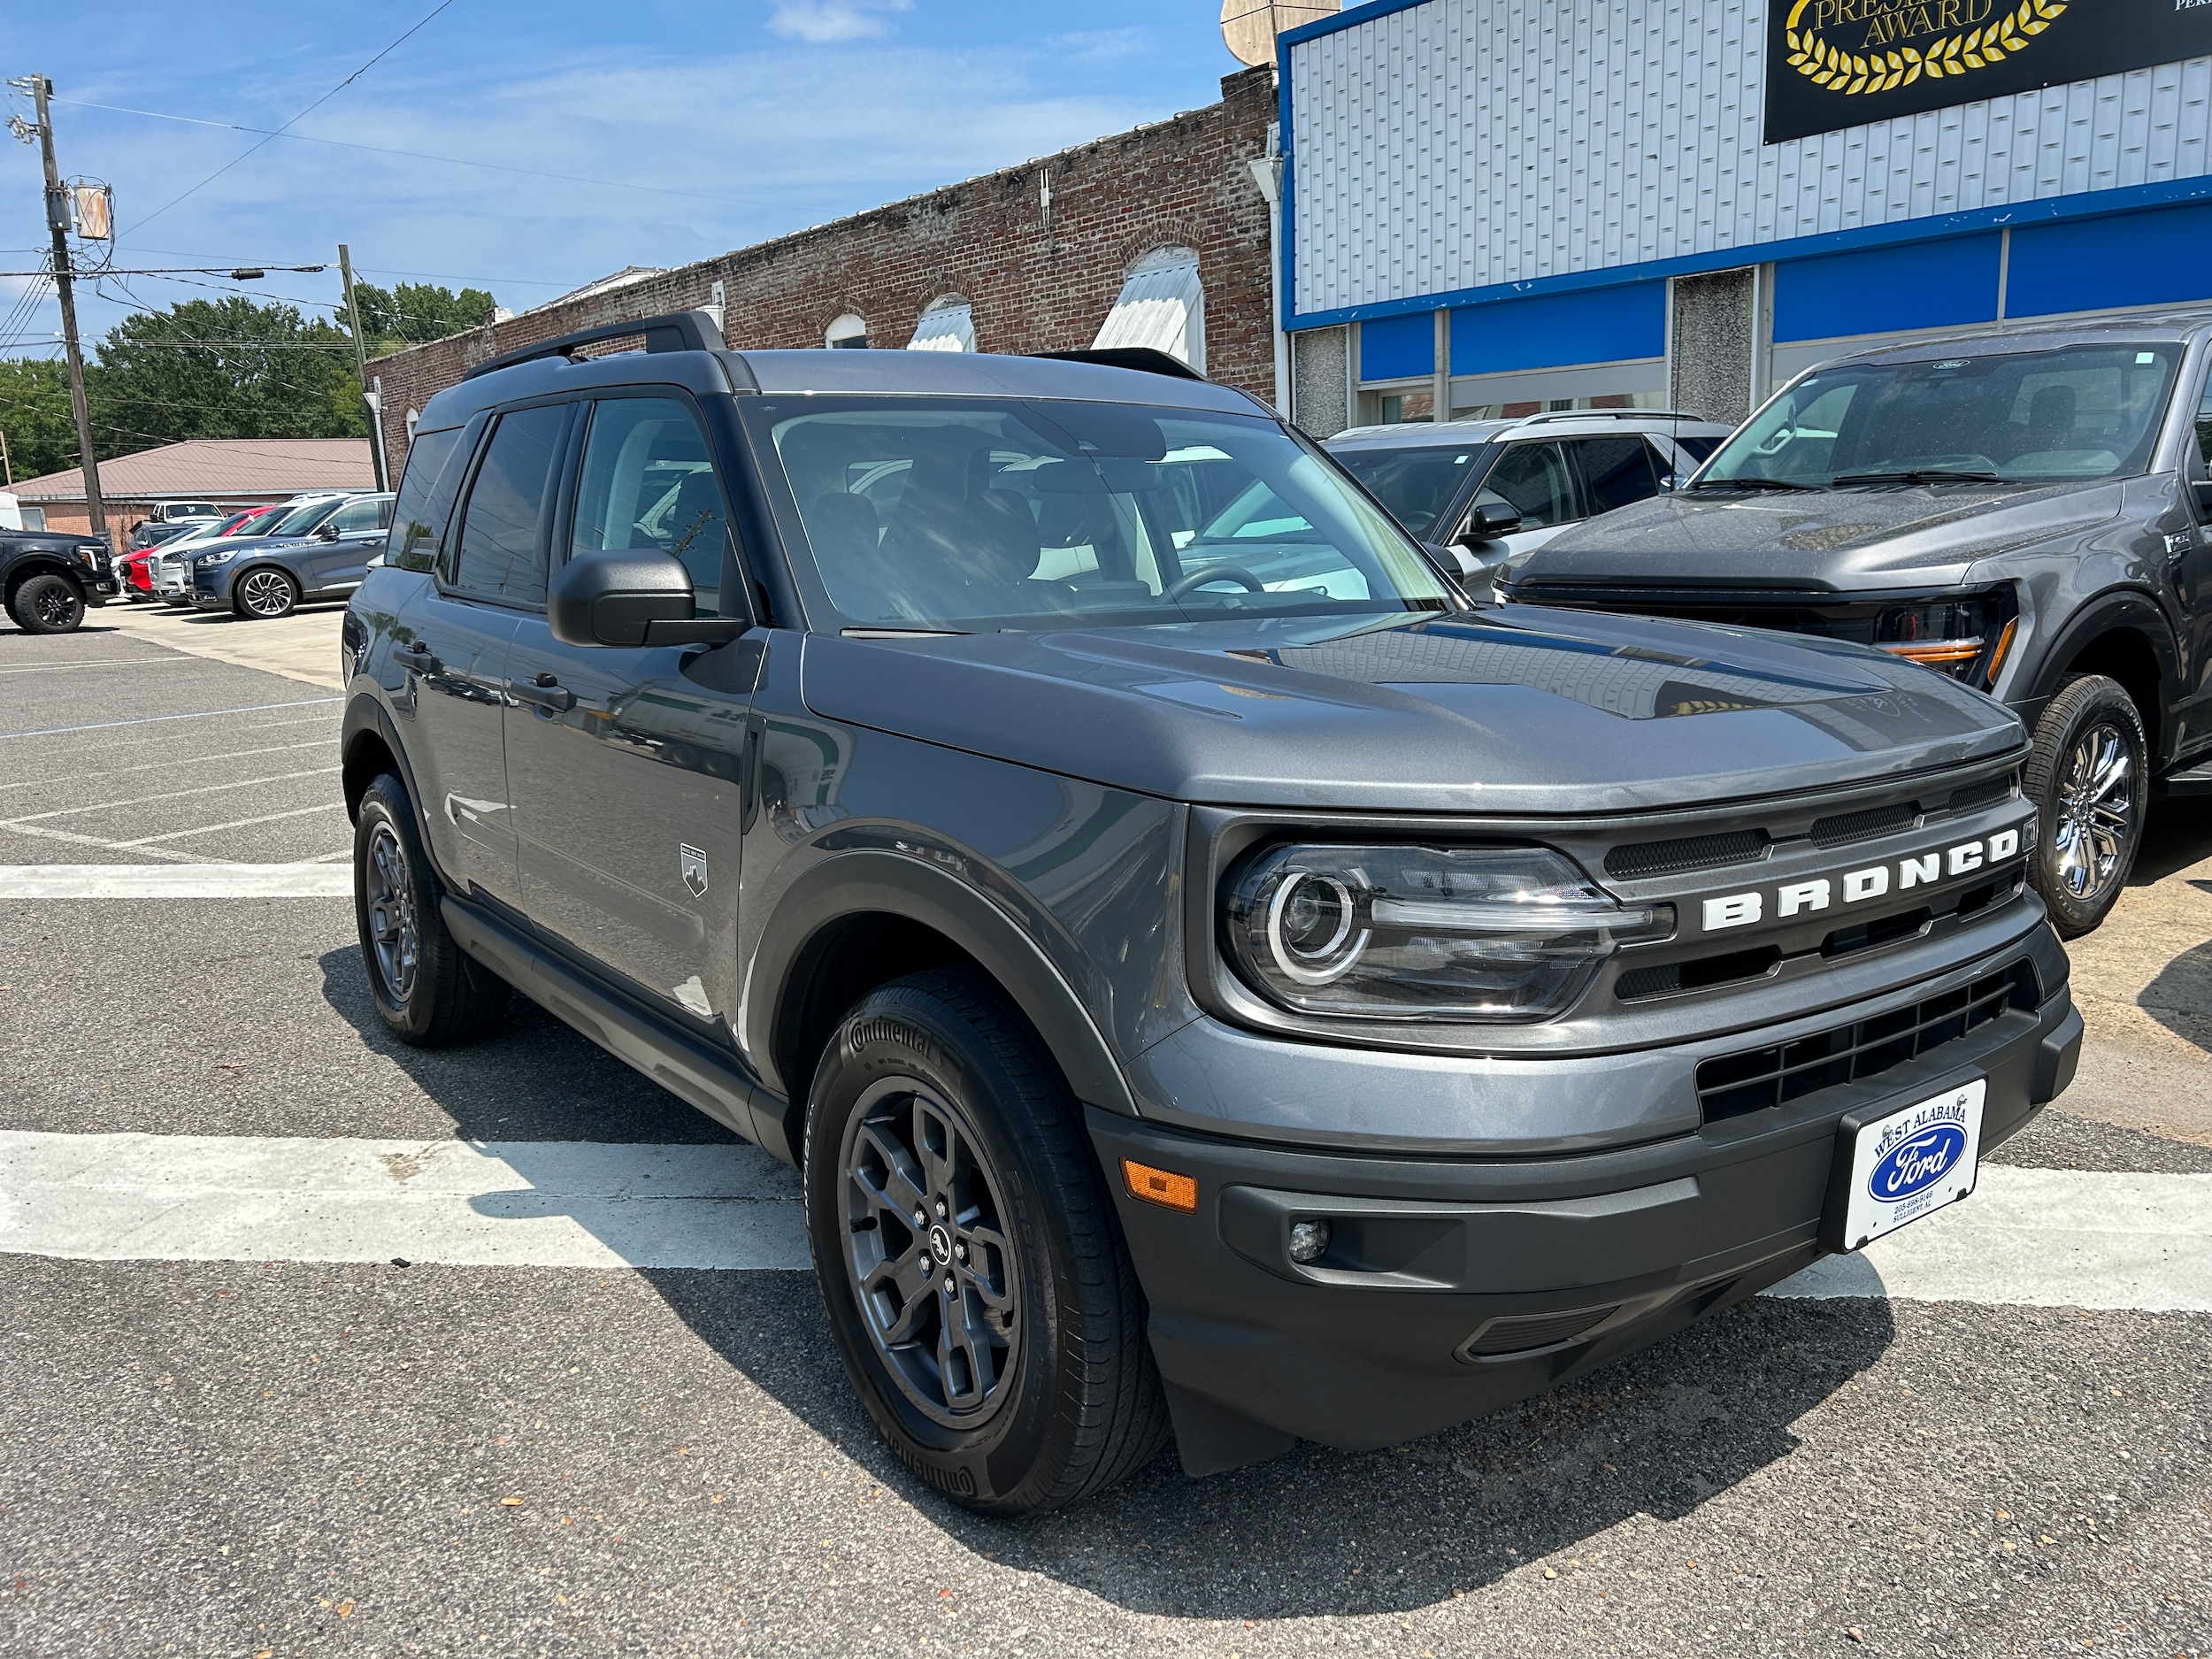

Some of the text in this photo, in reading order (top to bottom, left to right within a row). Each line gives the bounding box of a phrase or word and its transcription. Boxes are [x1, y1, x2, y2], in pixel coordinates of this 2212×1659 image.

[1859, 0, 1992, 50] AWARD
[1701, 828, 2019, 932] BRONCO
[849, 1015, 933, 1061] Continental
[1874, 1105, 1966, 1158] WEST ALABAMA
[1887, 1134, 1951, 1192] Ford
[1893, 1203, 1924, 1224] SULLIGENT
